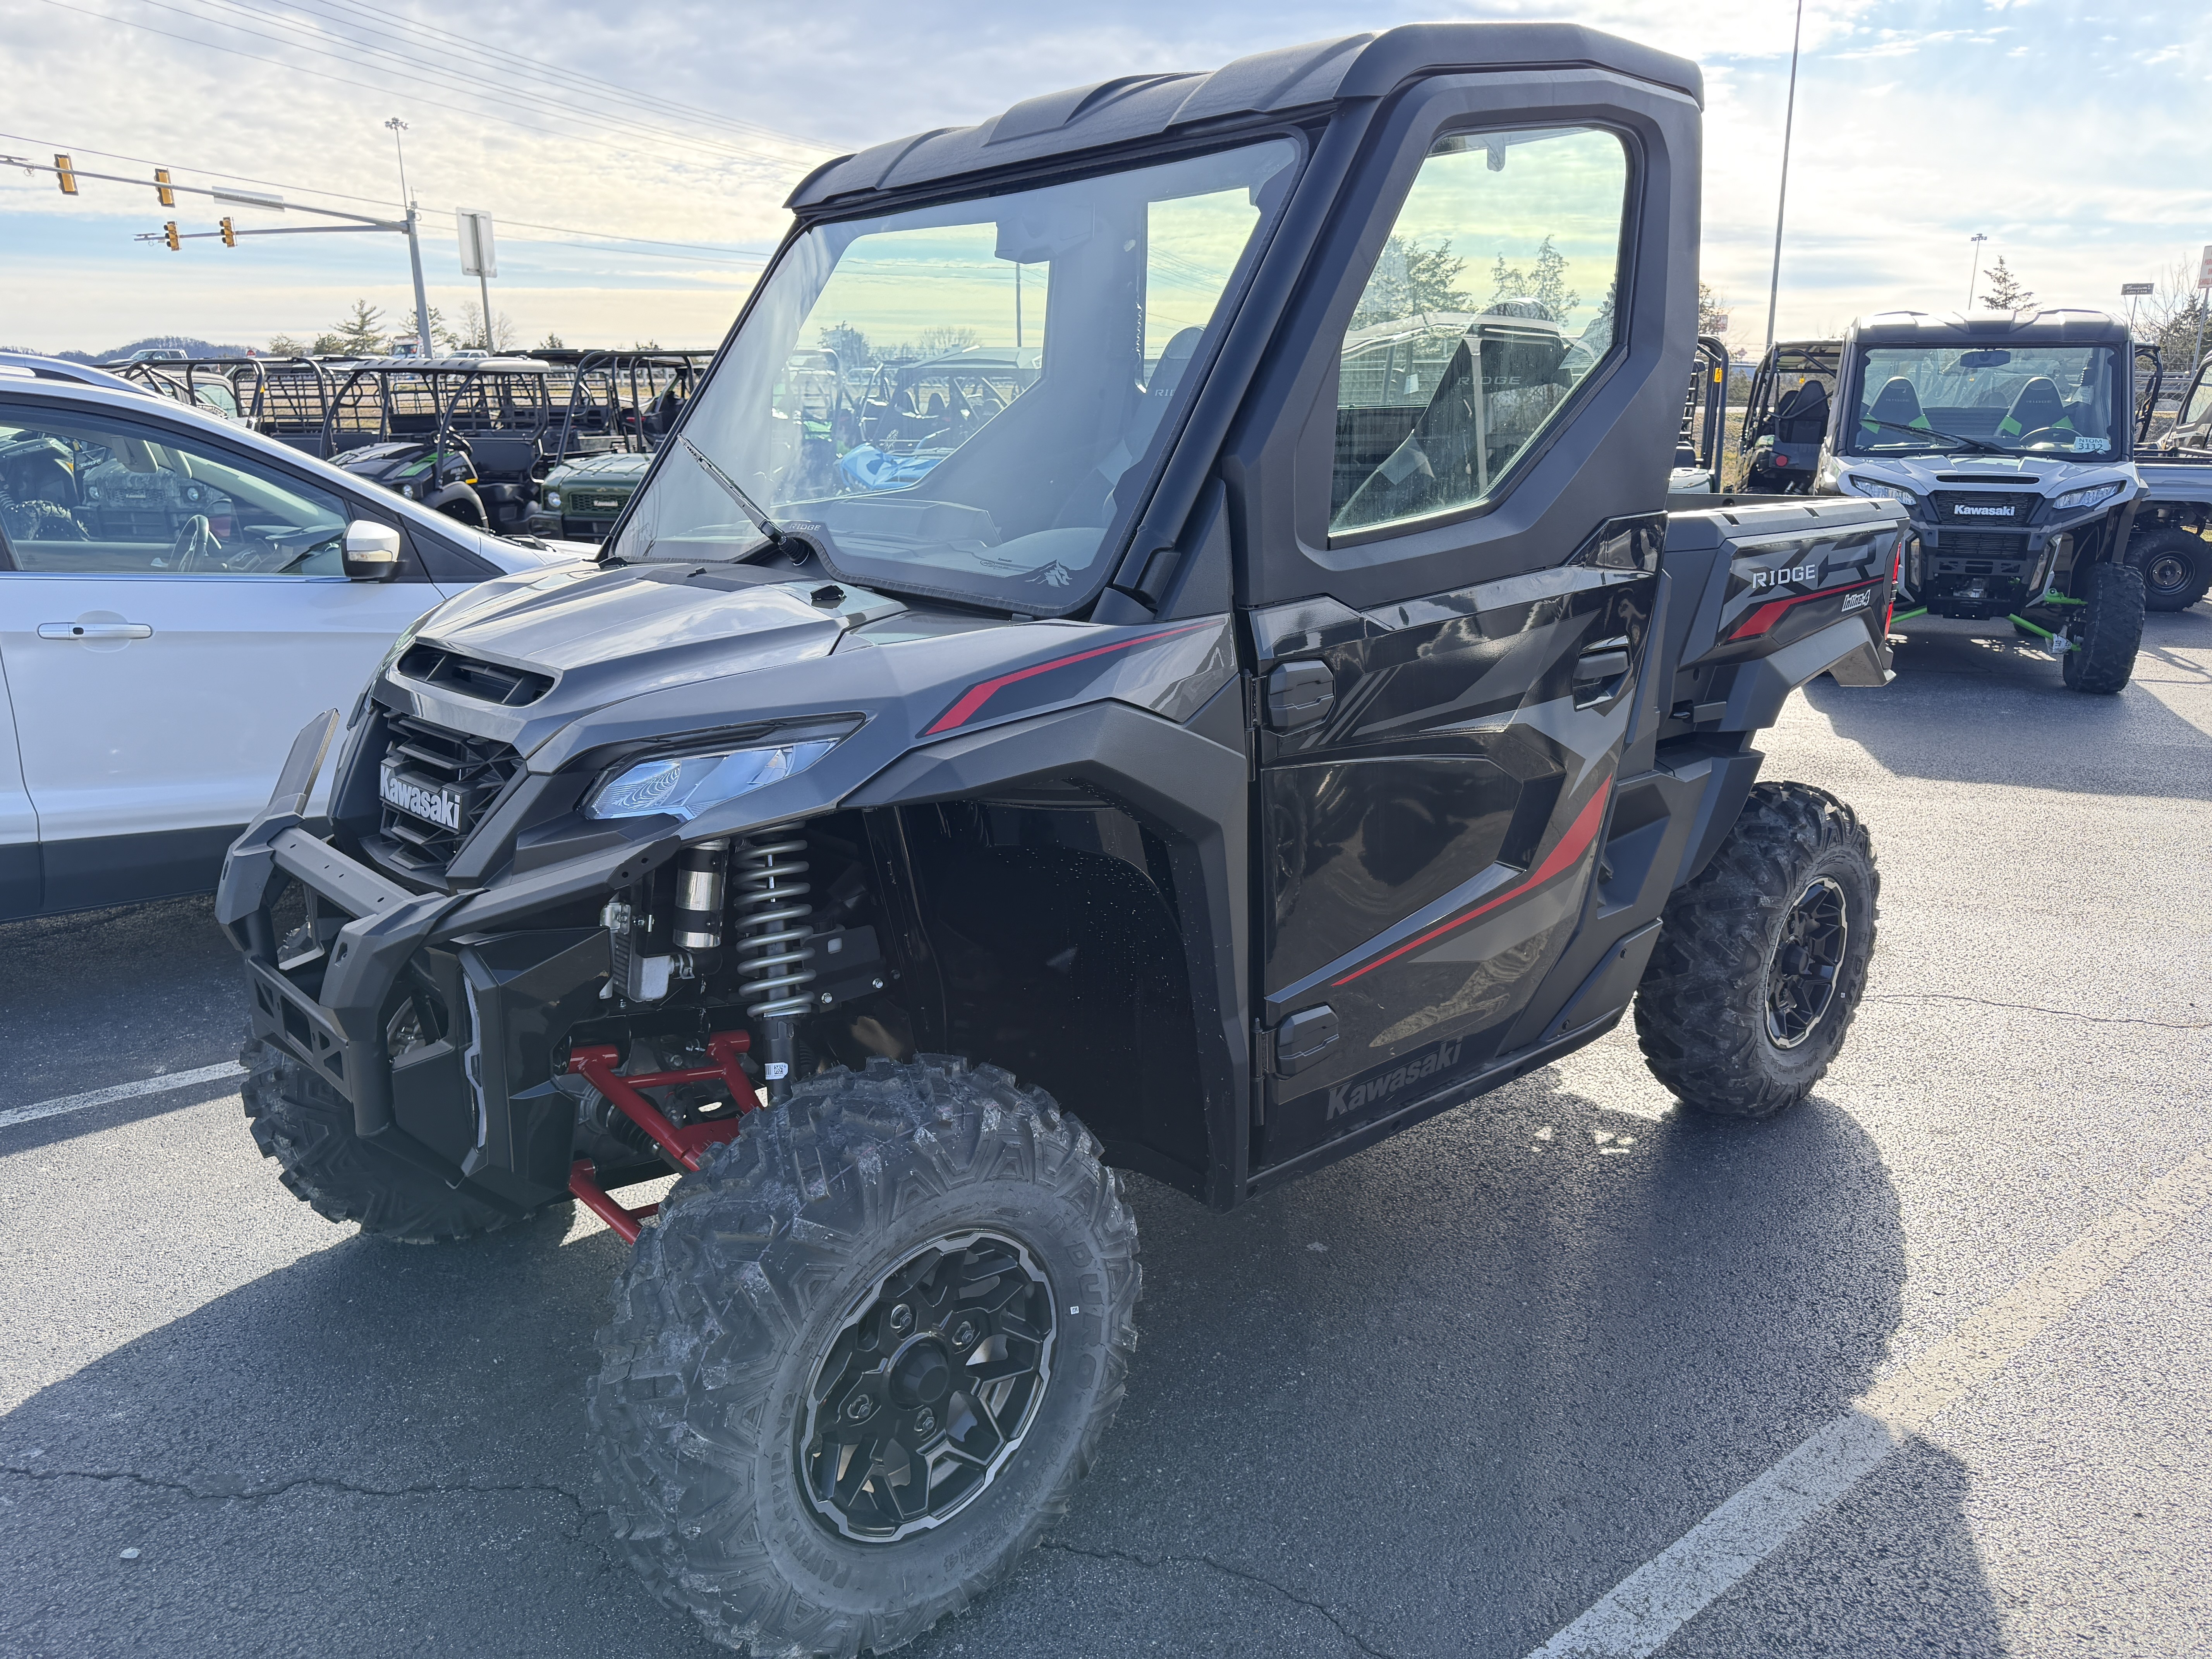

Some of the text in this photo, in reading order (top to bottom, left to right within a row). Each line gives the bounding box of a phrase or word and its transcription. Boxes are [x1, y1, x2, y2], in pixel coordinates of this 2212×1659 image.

[1457, 376, 1521, 385] RIDGE
[1954, 505, 2015, 516] Kawasaki
[1752, 564, 1815, 589] RIDGE
[380, 765, 460, 829] Kawasaki
[1326, 1036, 1463, 1121] Kawasaki
[1065, 1241, 1103, 1389] DURO
[771, 1451, 794, 1521] GRIP
